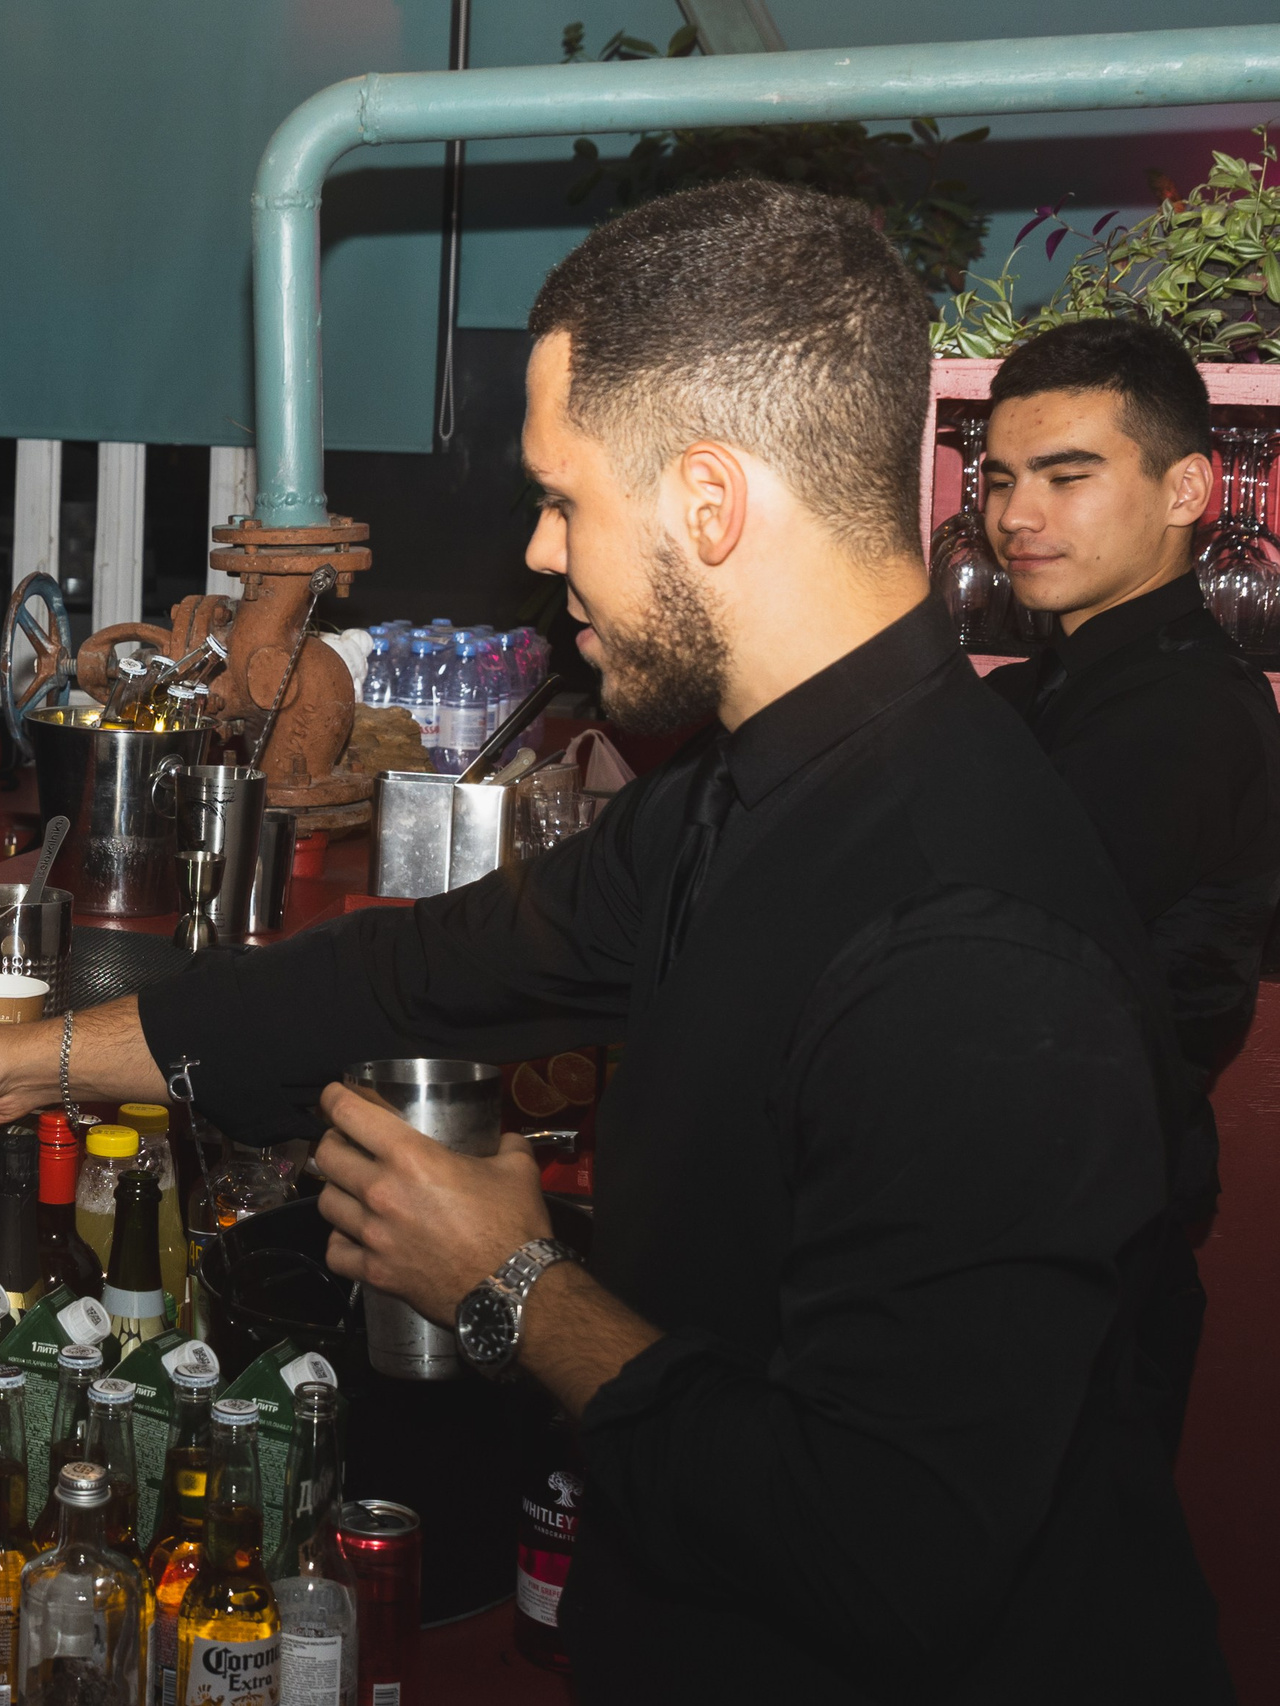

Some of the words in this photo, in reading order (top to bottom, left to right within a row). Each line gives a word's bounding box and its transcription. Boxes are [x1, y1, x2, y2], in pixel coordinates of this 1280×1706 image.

[32, 1341, 37, 1352] 1
[37, 1346, 58, 1355] ЛИТР
[135, 1387, 157, 1398] ЛИТР
[257, 1402, 279, 1413] ЛИТР
[522, 1496, 574, 1530] WHITLEY
[533, 1524, 576, 1542] HANDCRAFTE
[540, 1586, 560, 1598] GRAPE
[229, 1673, 272, 1692] Extra
